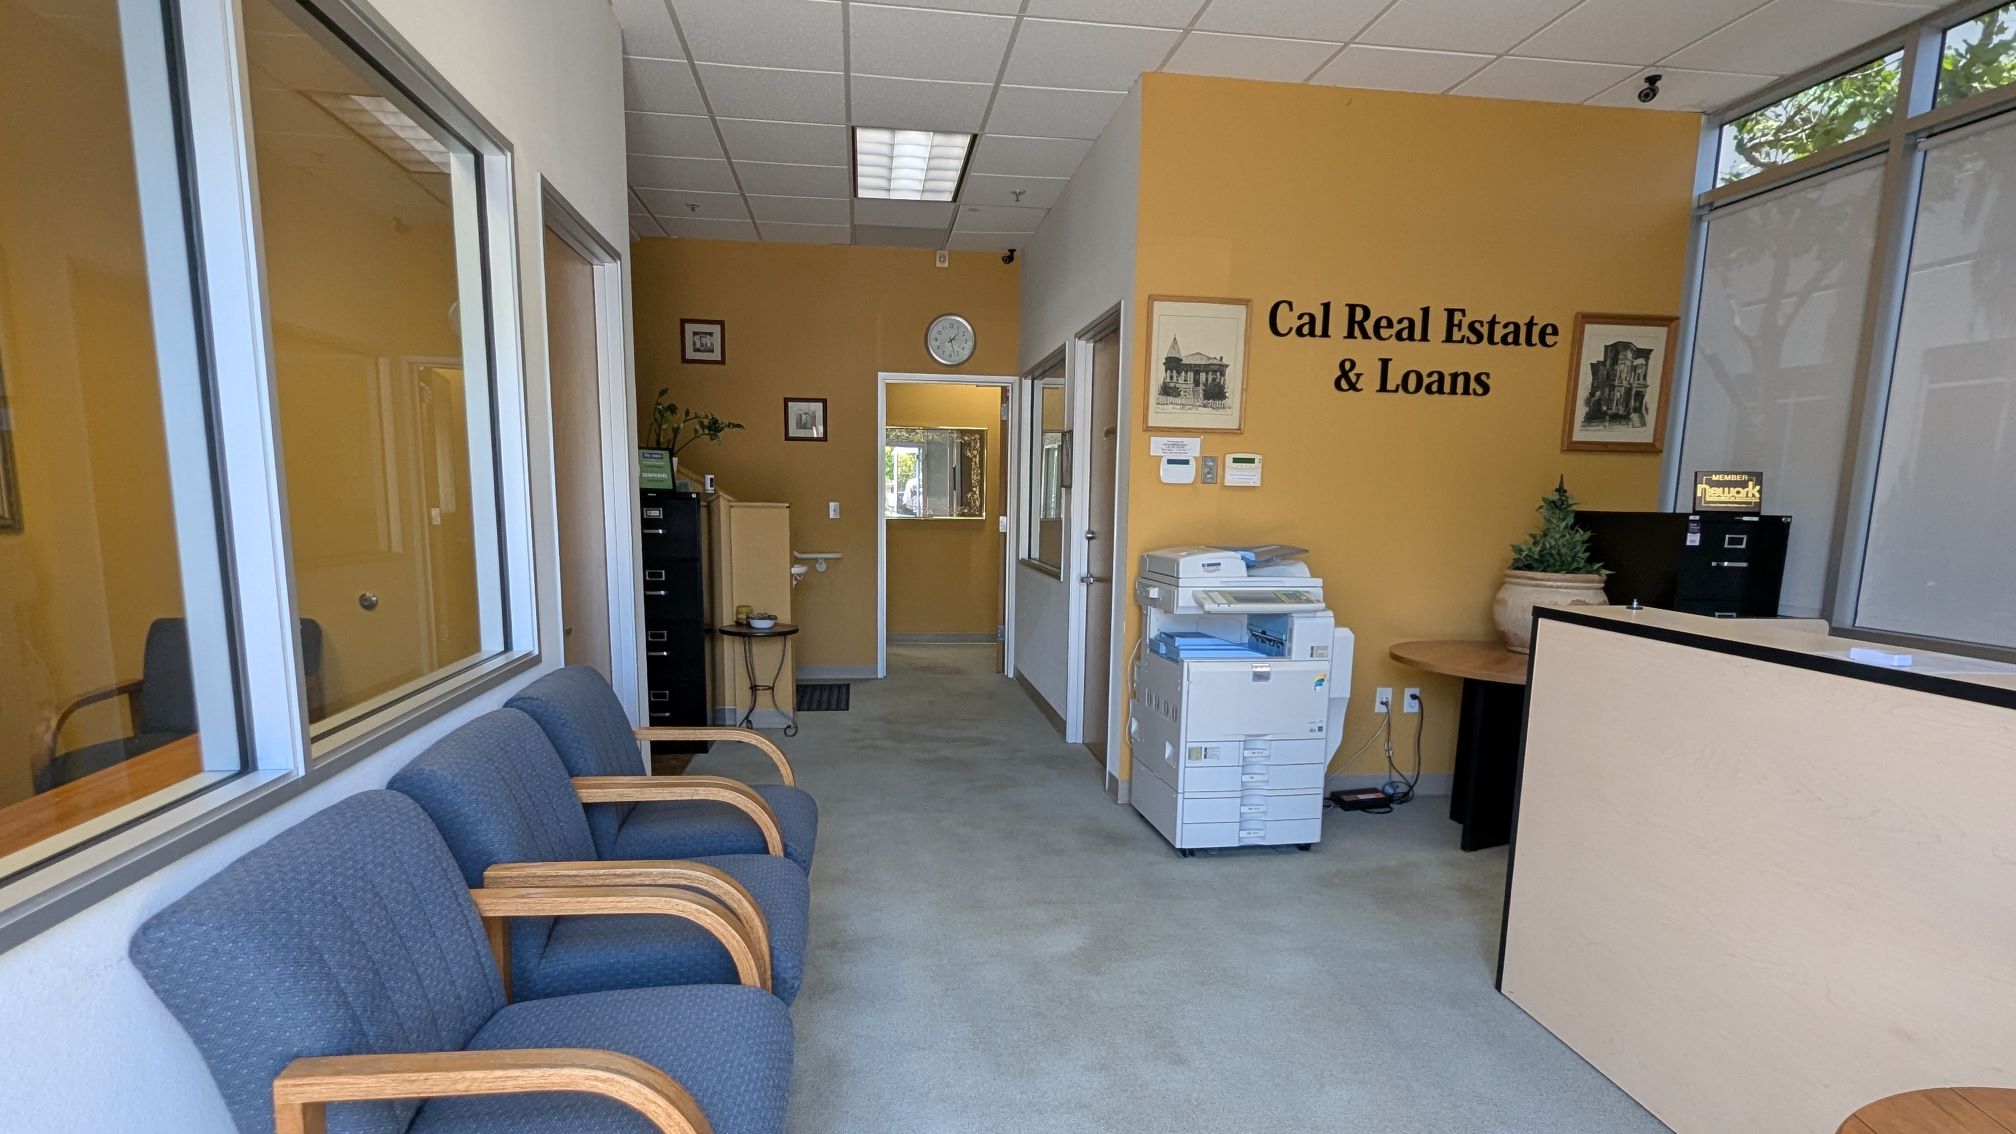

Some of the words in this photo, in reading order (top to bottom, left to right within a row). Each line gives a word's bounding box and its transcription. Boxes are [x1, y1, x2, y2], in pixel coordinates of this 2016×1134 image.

[1268, 299, 1331, 338] Cal
[1343, 303, 1430, 343] Real
[1441, 307, 1559, 348] Estate
[1334, 358, 1364, 393] &
[1376, 357, 1491, 397] Loans
